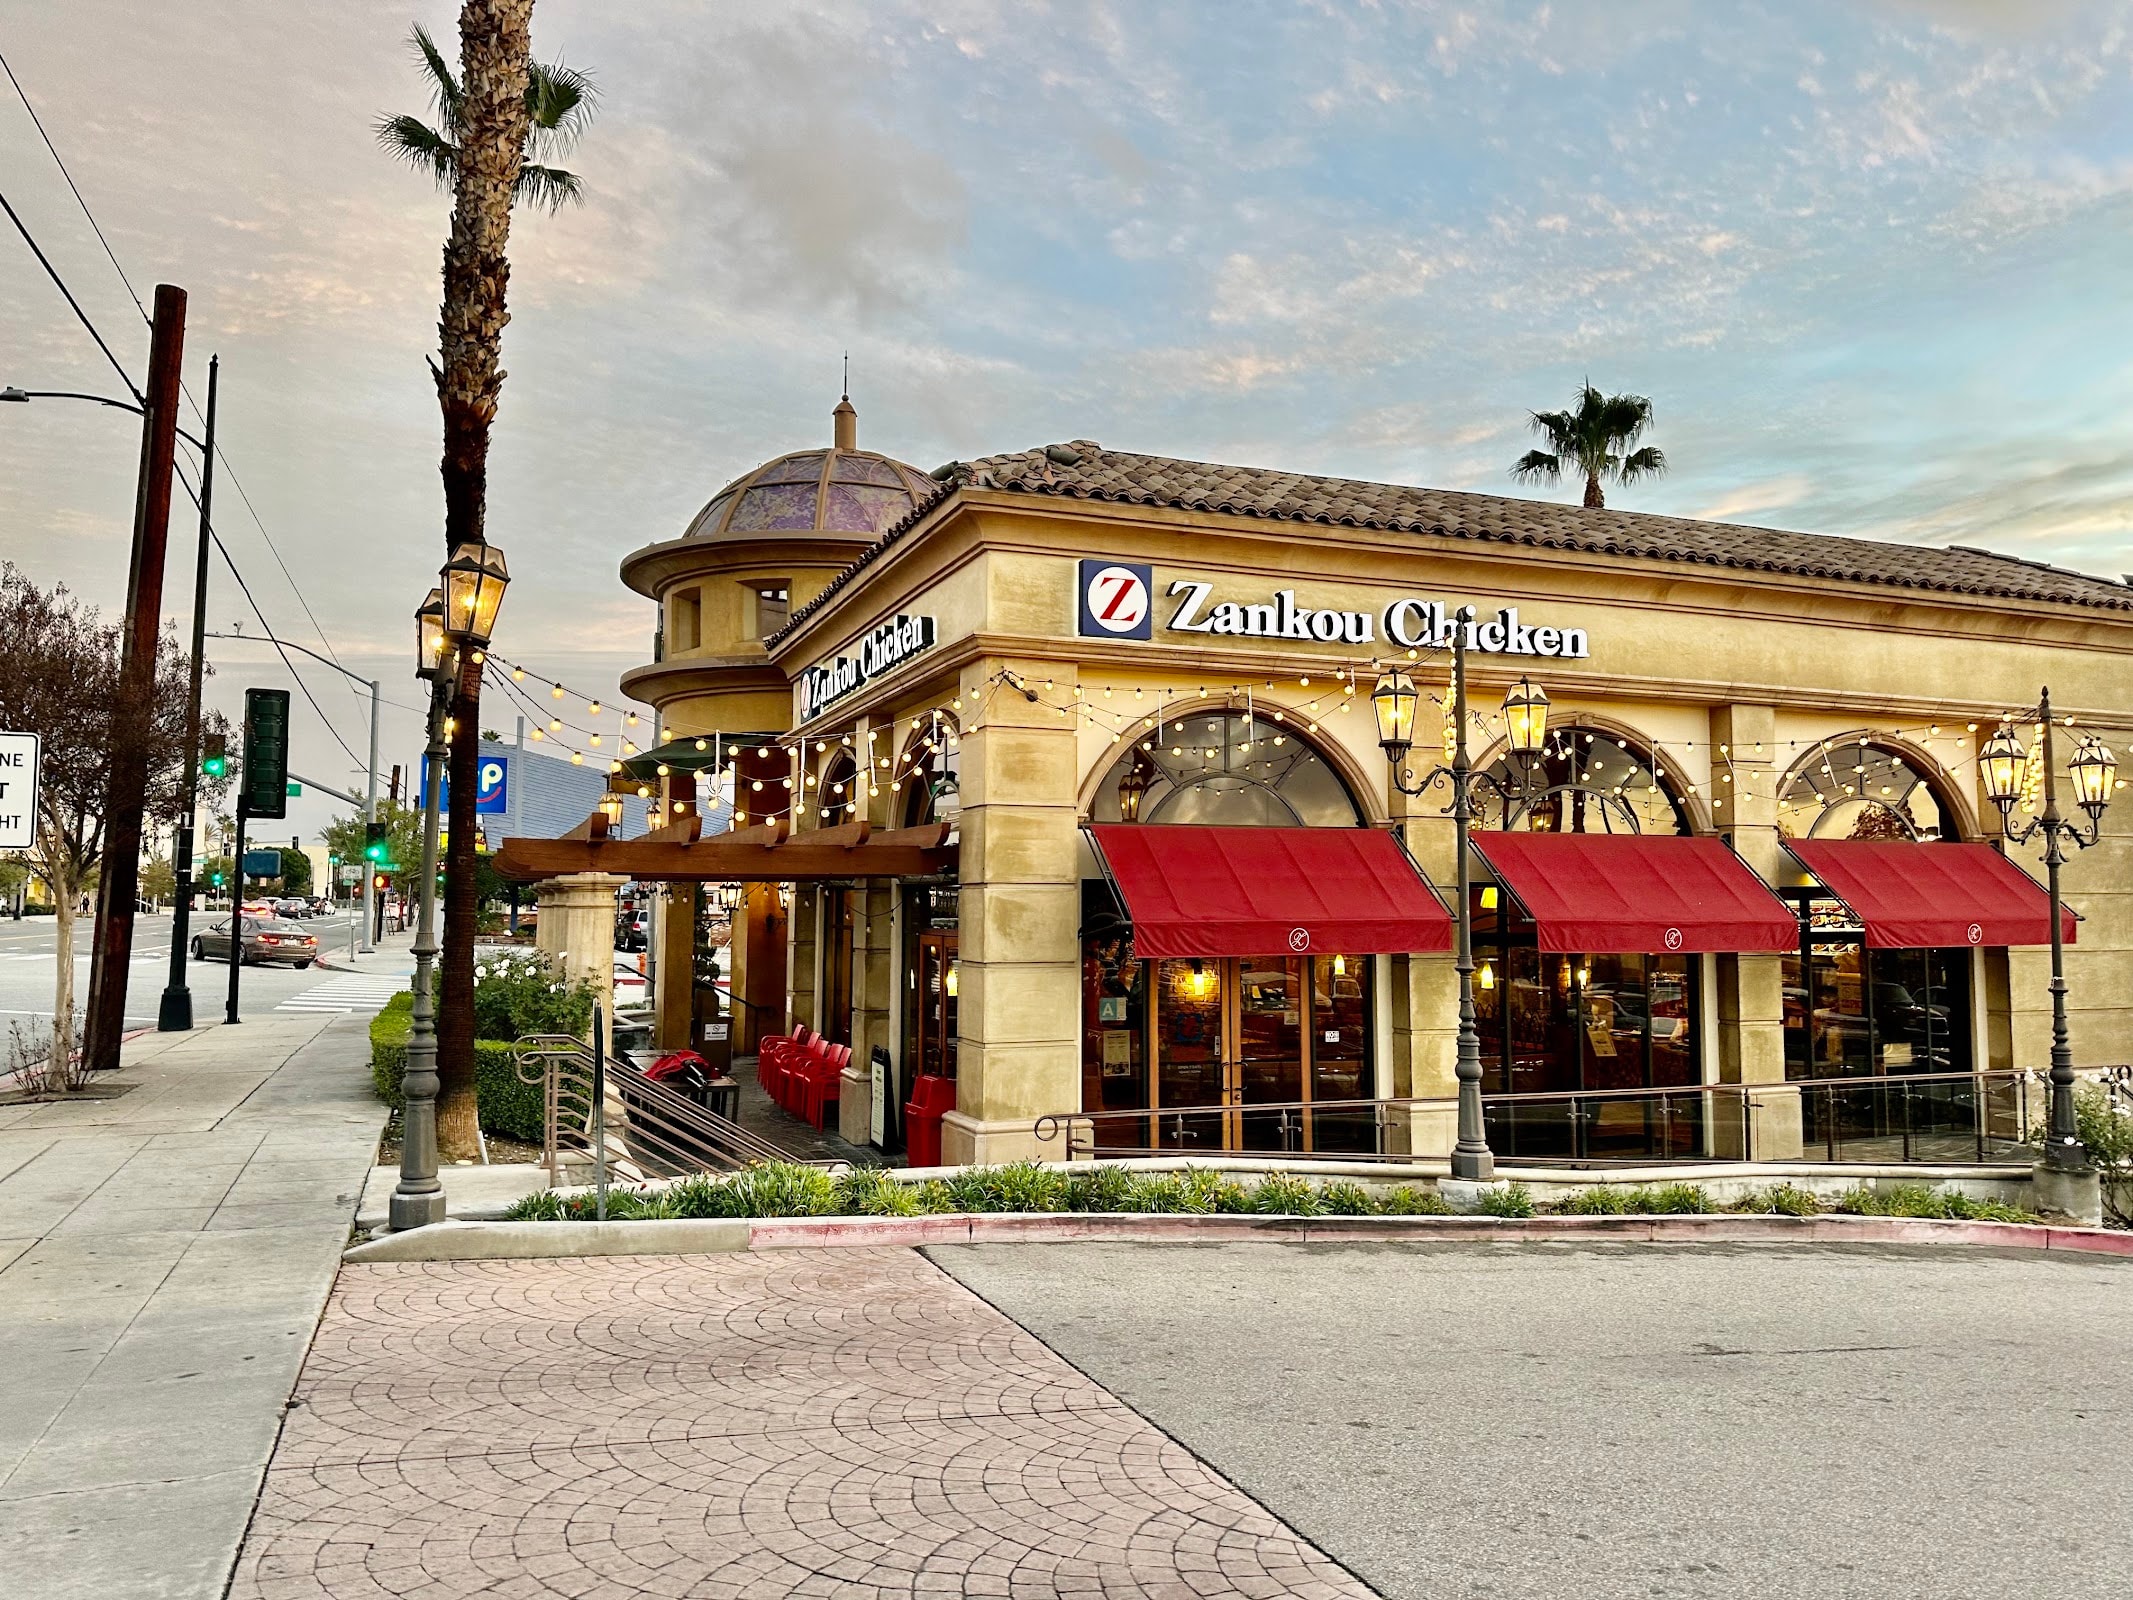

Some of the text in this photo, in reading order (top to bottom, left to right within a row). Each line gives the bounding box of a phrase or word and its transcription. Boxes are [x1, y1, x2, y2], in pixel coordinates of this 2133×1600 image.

[1100, 577, 1591, 658] Z Zankou Chicken
[811, 656, 857, 710] Zankou
[860, 614, 924, 679] Chicken
[1102, 1002, 1114, 1016] A
